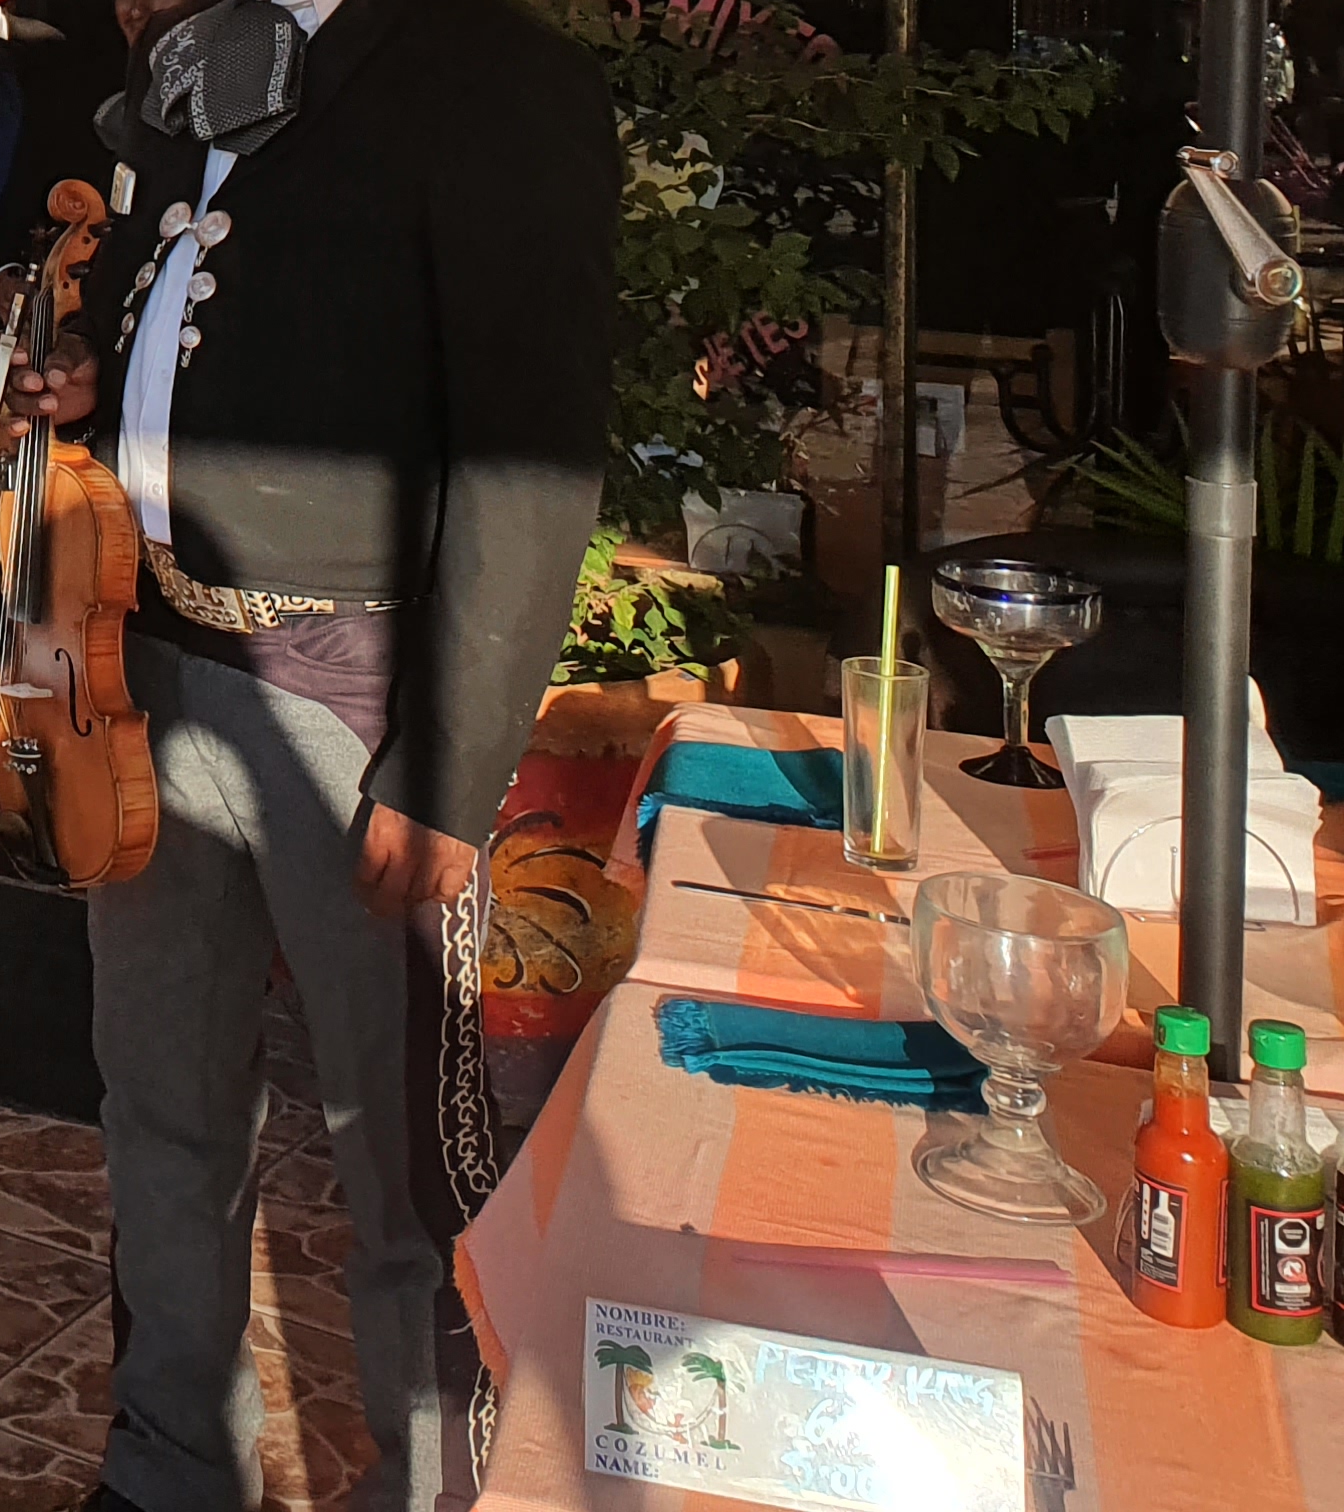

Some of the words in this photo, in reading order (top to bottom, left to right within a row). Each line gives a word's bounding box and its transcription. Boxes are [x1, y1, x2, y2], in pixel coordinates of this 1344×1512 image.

[594, 1302, 687, 1333] NOMBRE:
[594, 1322, 694, 1349] RESTAURANT
[594, 1433, 728, 1472] COZUMEL
[594, 1454, 660, 1479] NAME:
